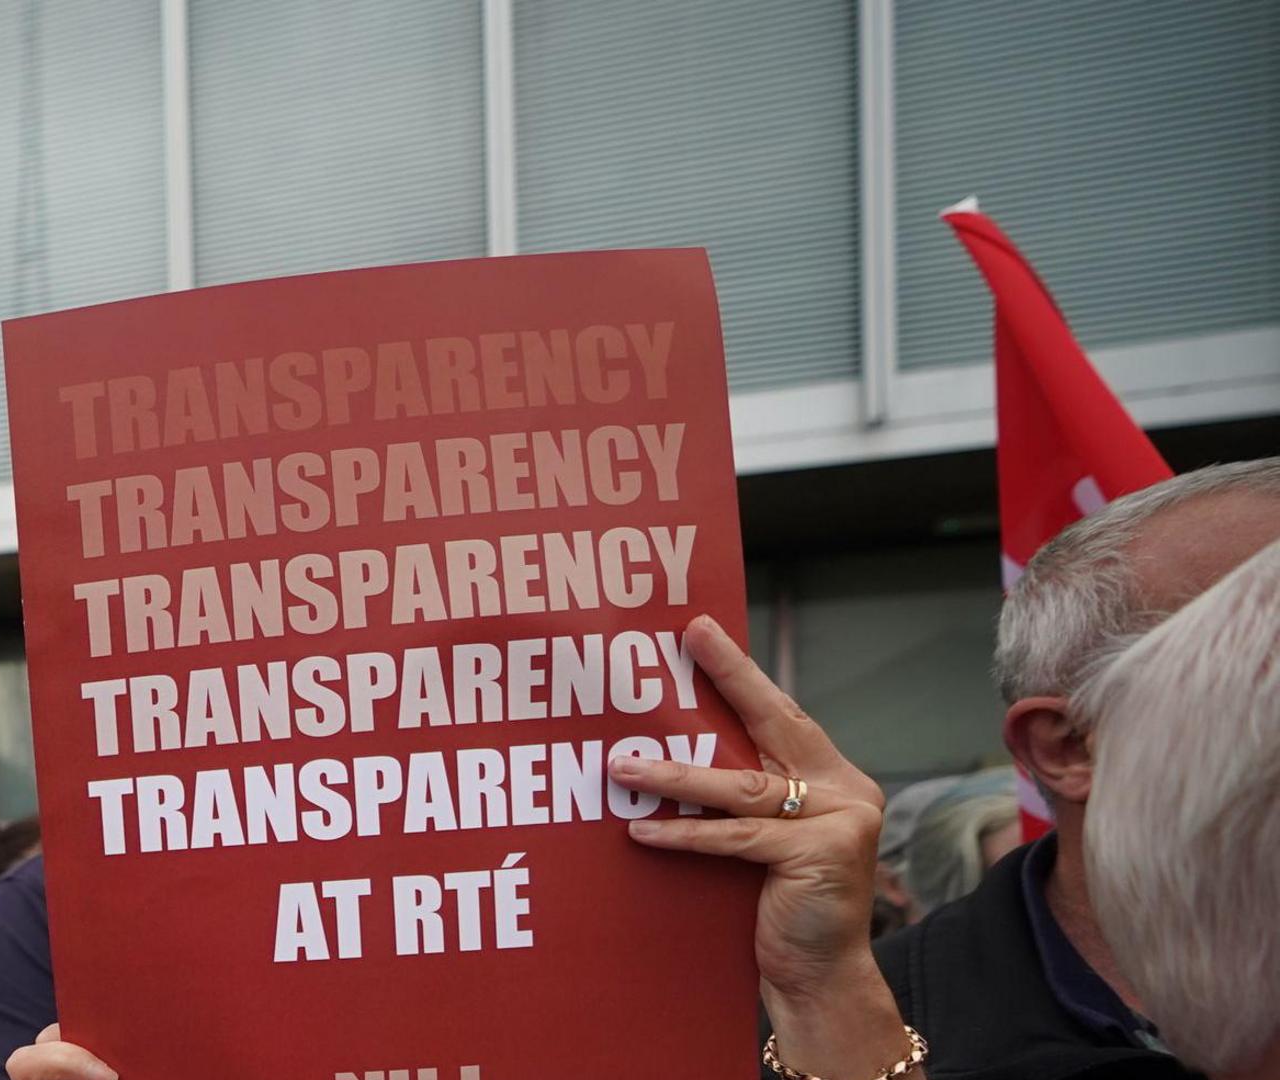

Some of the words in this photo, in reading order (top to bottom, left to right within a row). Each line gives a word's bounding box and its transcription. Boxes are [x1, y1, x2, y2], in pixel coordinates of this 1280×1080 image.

[59, 321, 675, 460] TRANSPARENCY
[66, 423, 686, 558] TRANSPARENCY
[74, 525, 697, 658] TRANSPARENCY
[81, 631, 699, 757] TRANSPARENCY
[88, 733, 718, 856] TRANSPARENCY
[273, 878, 372, 963] AT
[392, 852, 534, 956] RTÉ
